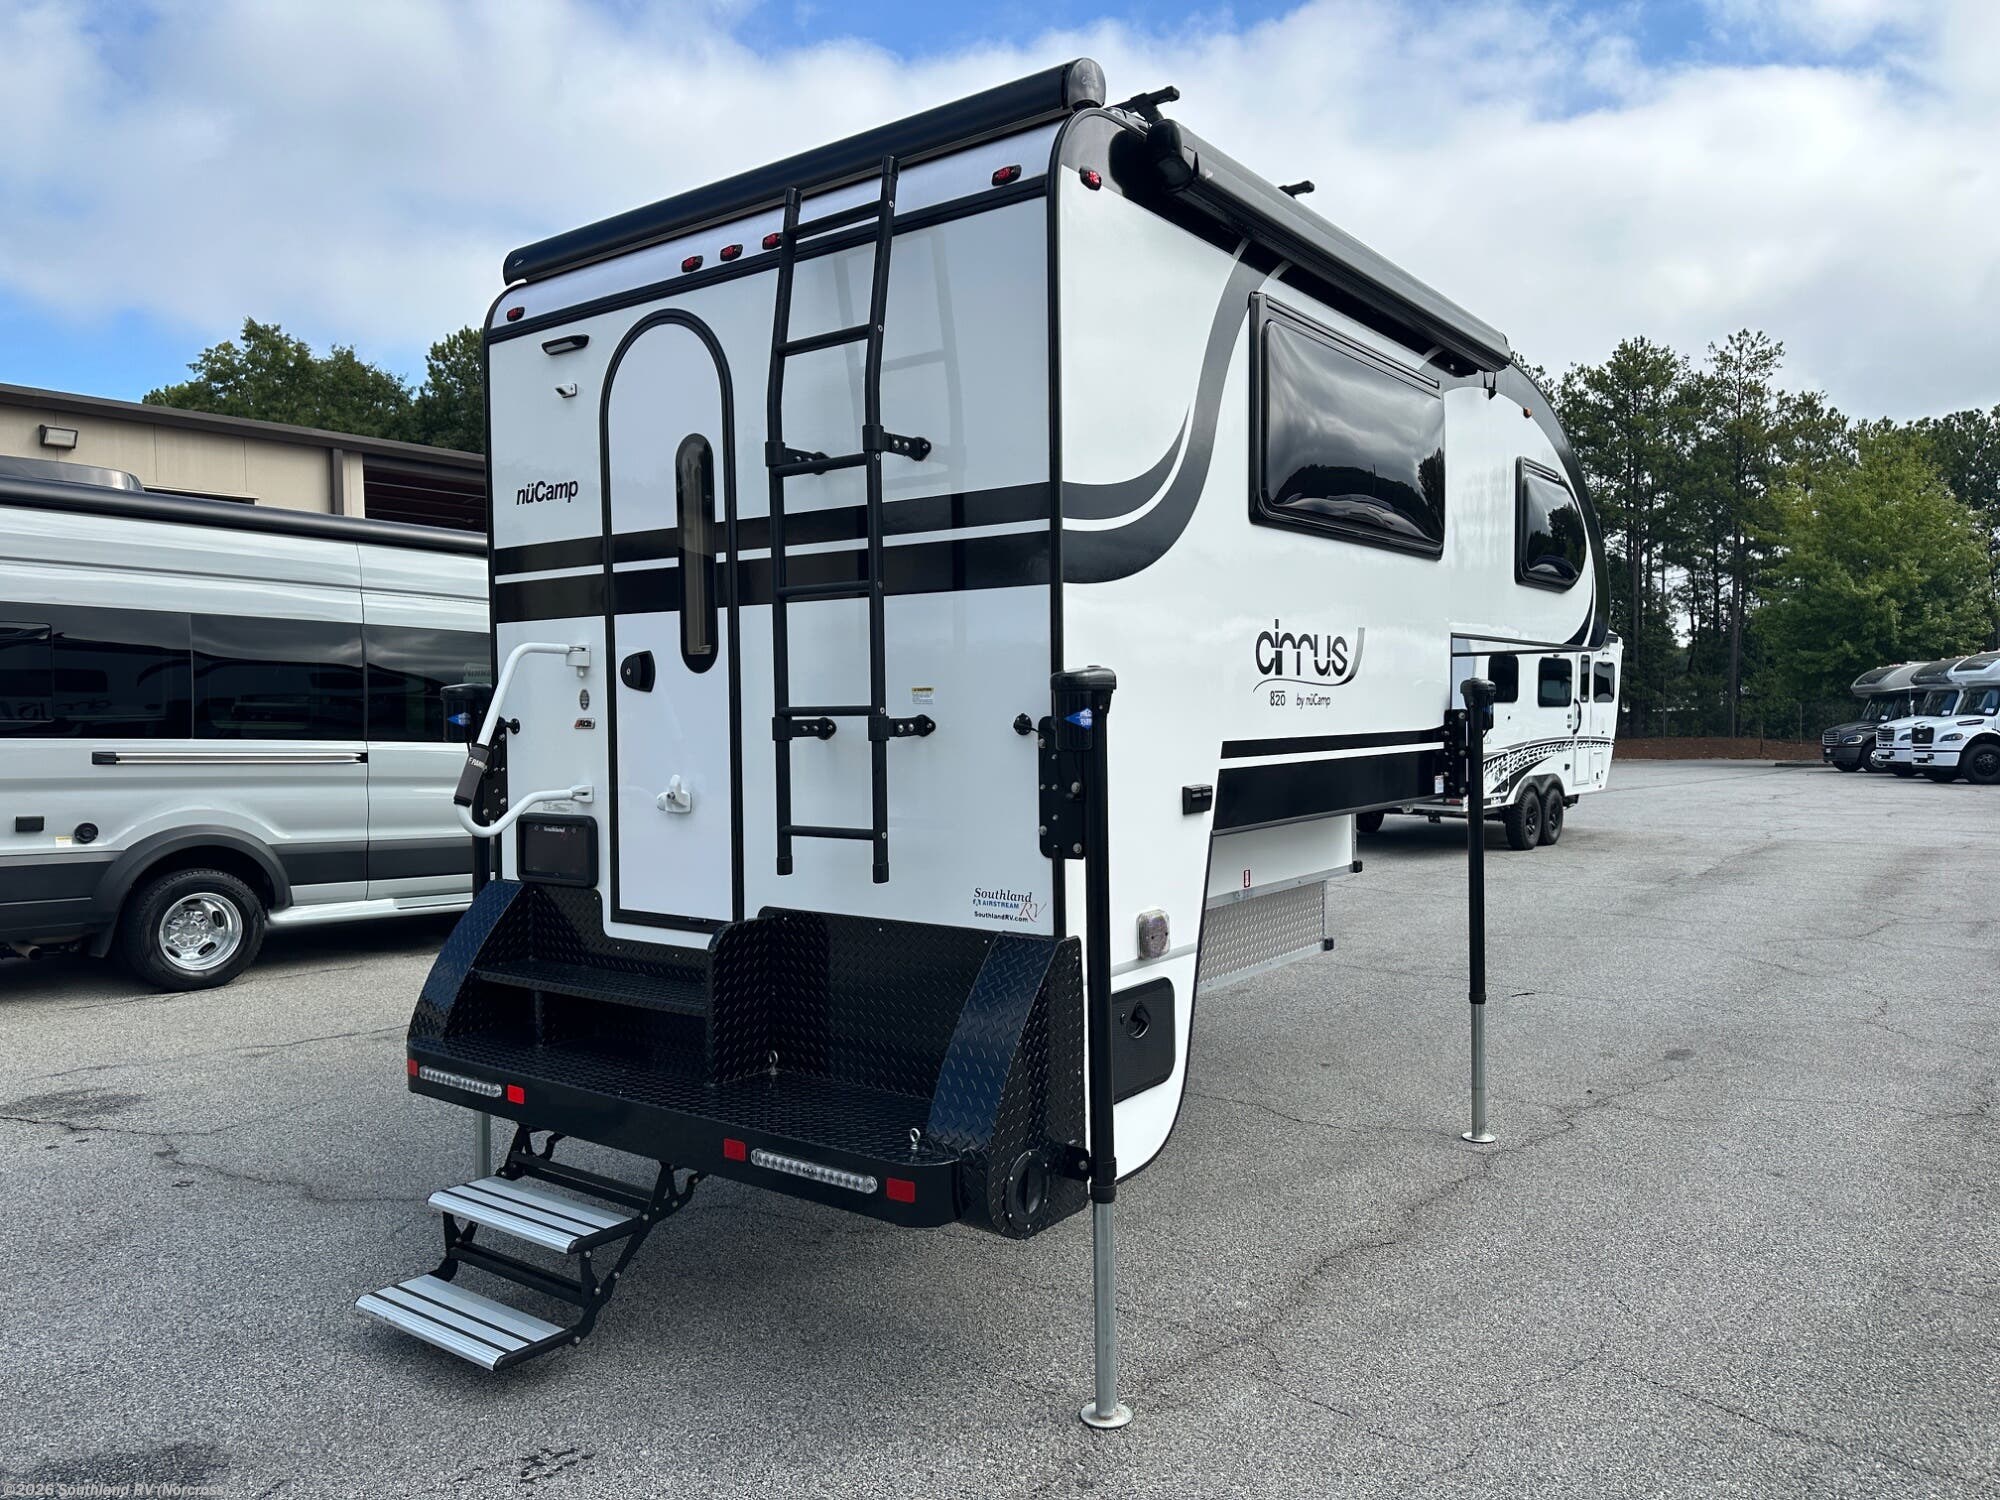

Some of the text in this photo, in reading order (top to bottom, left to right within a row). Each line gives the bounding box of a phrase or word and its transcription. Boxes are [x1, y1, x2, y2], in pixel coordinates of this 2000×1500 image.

[516, 480, 579, 505] nüCamp
[1255, 618, 1348, 677] cirrus
[1270, 690, 1286, 706] 820
[1296, 694, 1305, 710] by
[974, 887, 1032, 903] Southland
[982, 900, 1020, 909] AIRSTREAM
[974, 911, 1029, 923] SouthlandRV.com
